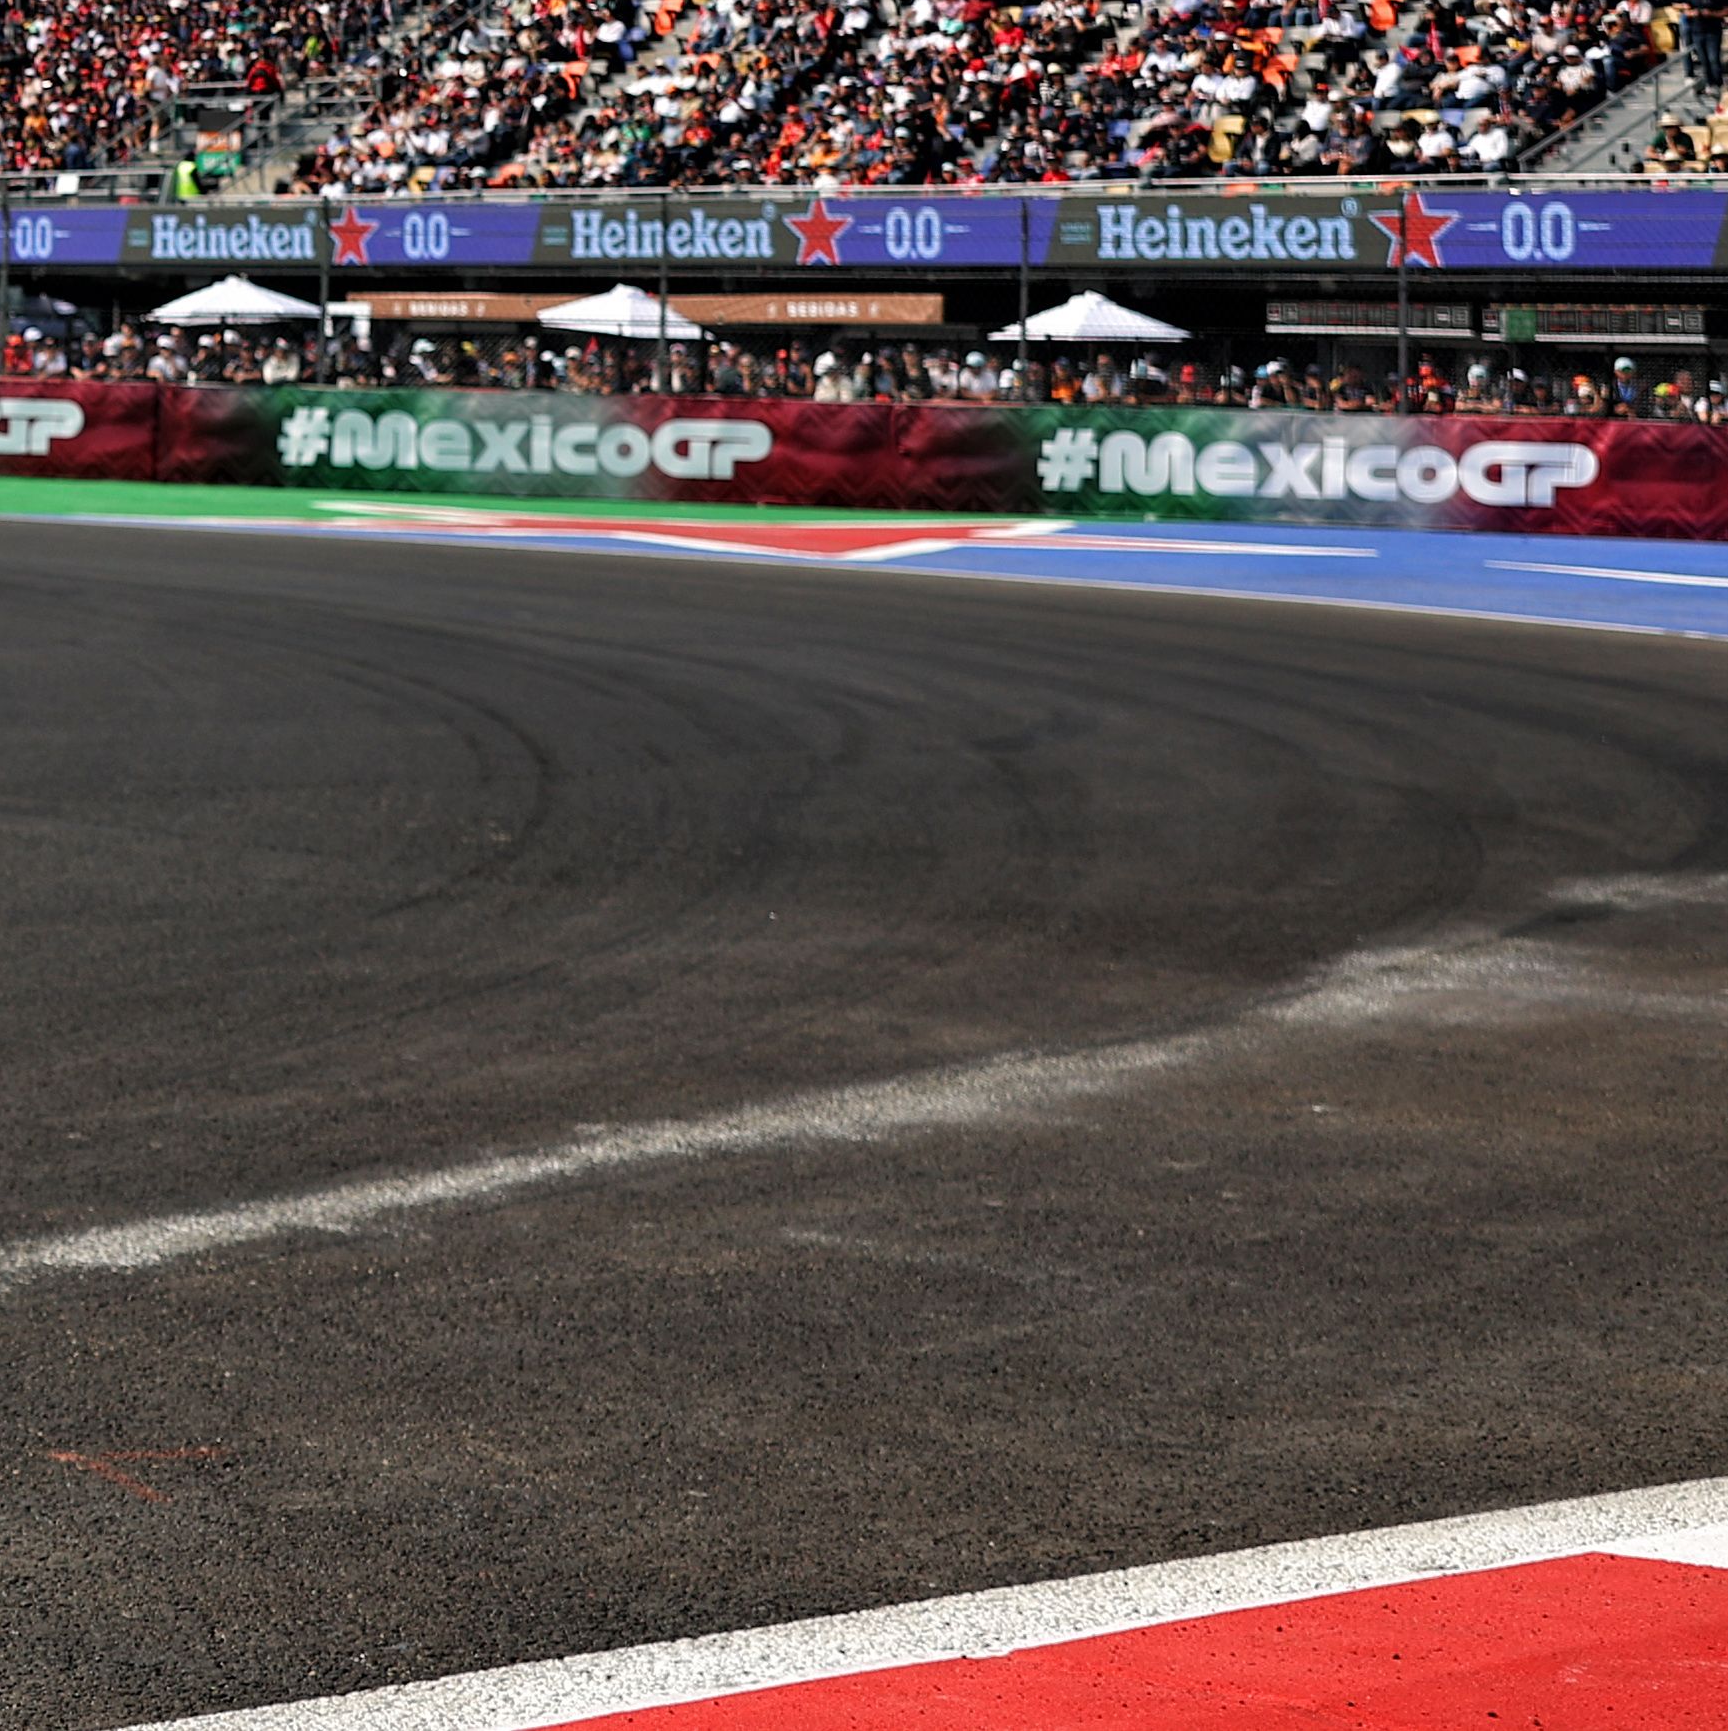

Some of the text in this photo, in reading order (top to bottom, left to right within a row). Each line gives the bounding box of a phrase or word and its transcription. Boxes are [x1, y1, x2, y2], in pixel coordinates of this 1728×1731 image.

[14, 217, 54, 259] 0.0
[402, 212, 449, 260] 0.0
[885, 206, 942, 260] 0.0
[1501, 200, 1576, 260] 0.0
[278, 406, 774, 481] #MexicoGP
[1037, 427, 1600, 509] #MexicoGP
